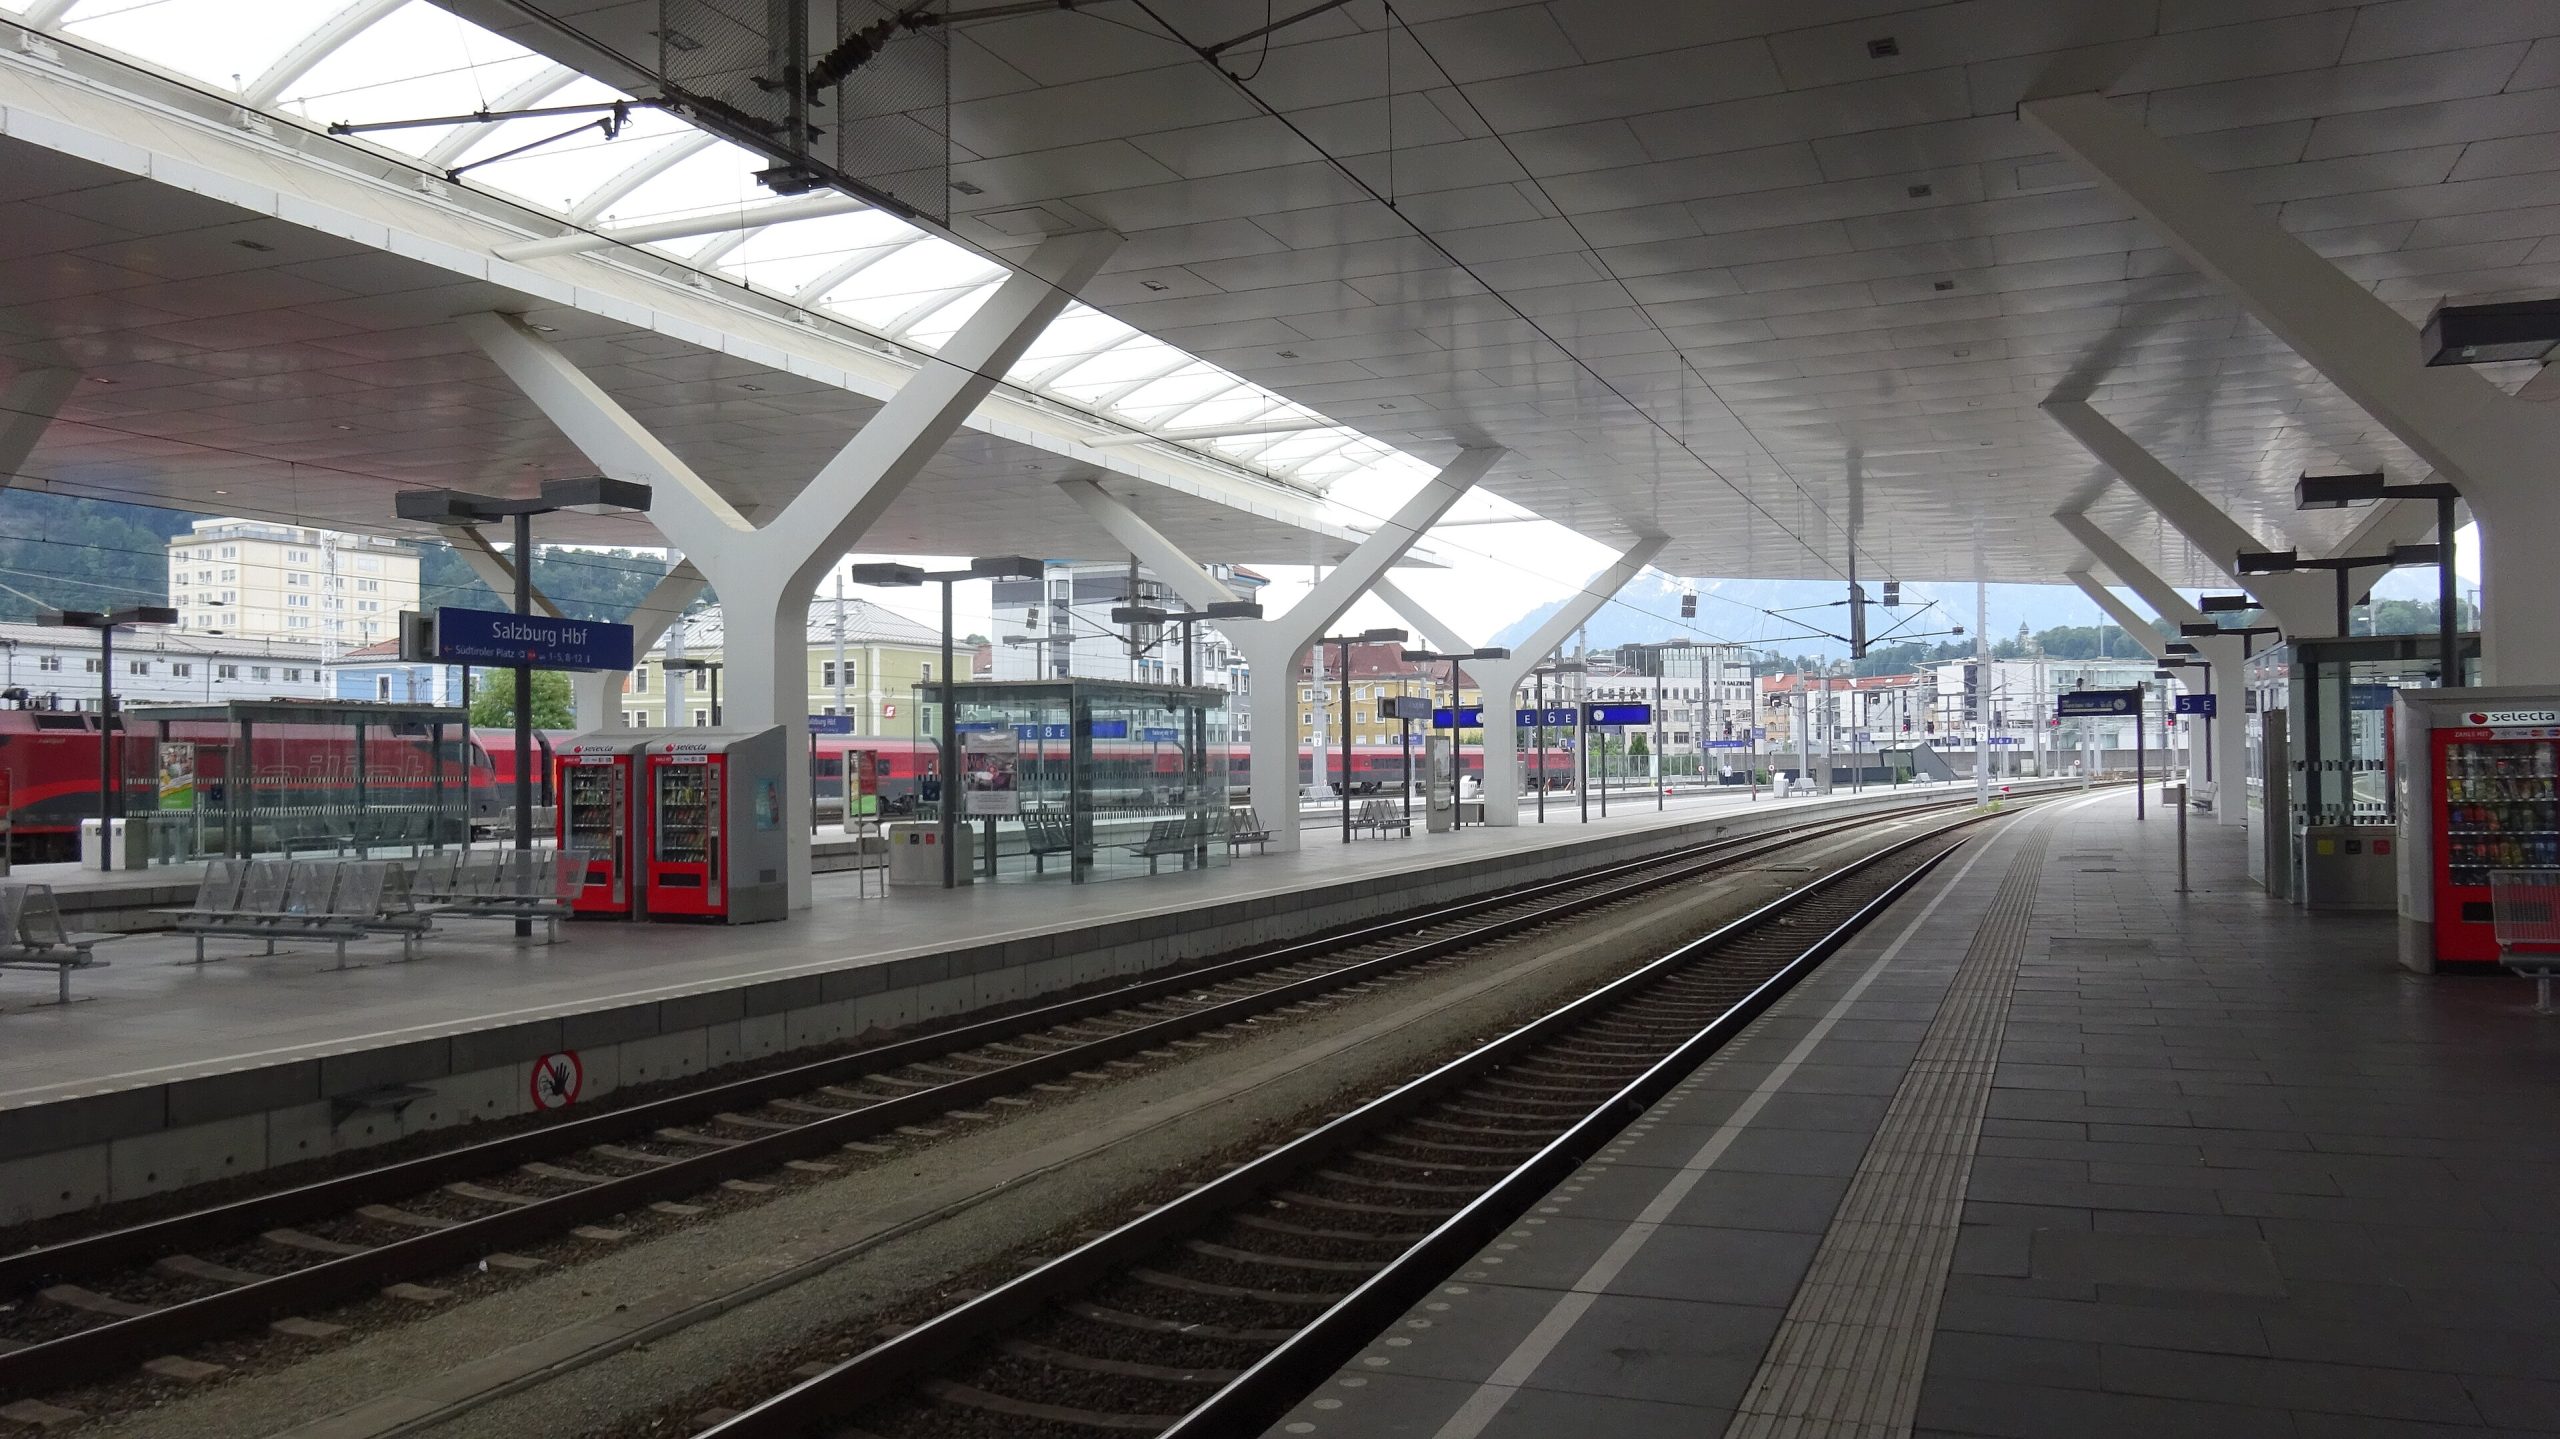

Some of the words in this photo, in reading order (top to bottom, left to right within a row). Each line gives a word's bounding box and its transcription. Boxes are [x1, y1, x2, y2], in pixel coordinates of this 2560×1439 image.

[493, 622, 557, 647] Salzburg
[562, 628, 588, 645] Hbf
[456, 645, 495, 656] Südtiroler
[497, 648, 515, 658] Platz
[2181, 699, 2191, 711] 5
[2204, 701, 2211, 711] E
[1525, 714, 1531, 724] E
[1548, 711, 1556, 723] 6
[1566, 714, 1572, 723] E
[2491, 712, 2555, 721] selecta
[1026, 729, 1032, 738] E
[1045, 727, 1052, 738] 8
[1060, 729, 1065, 737] E
